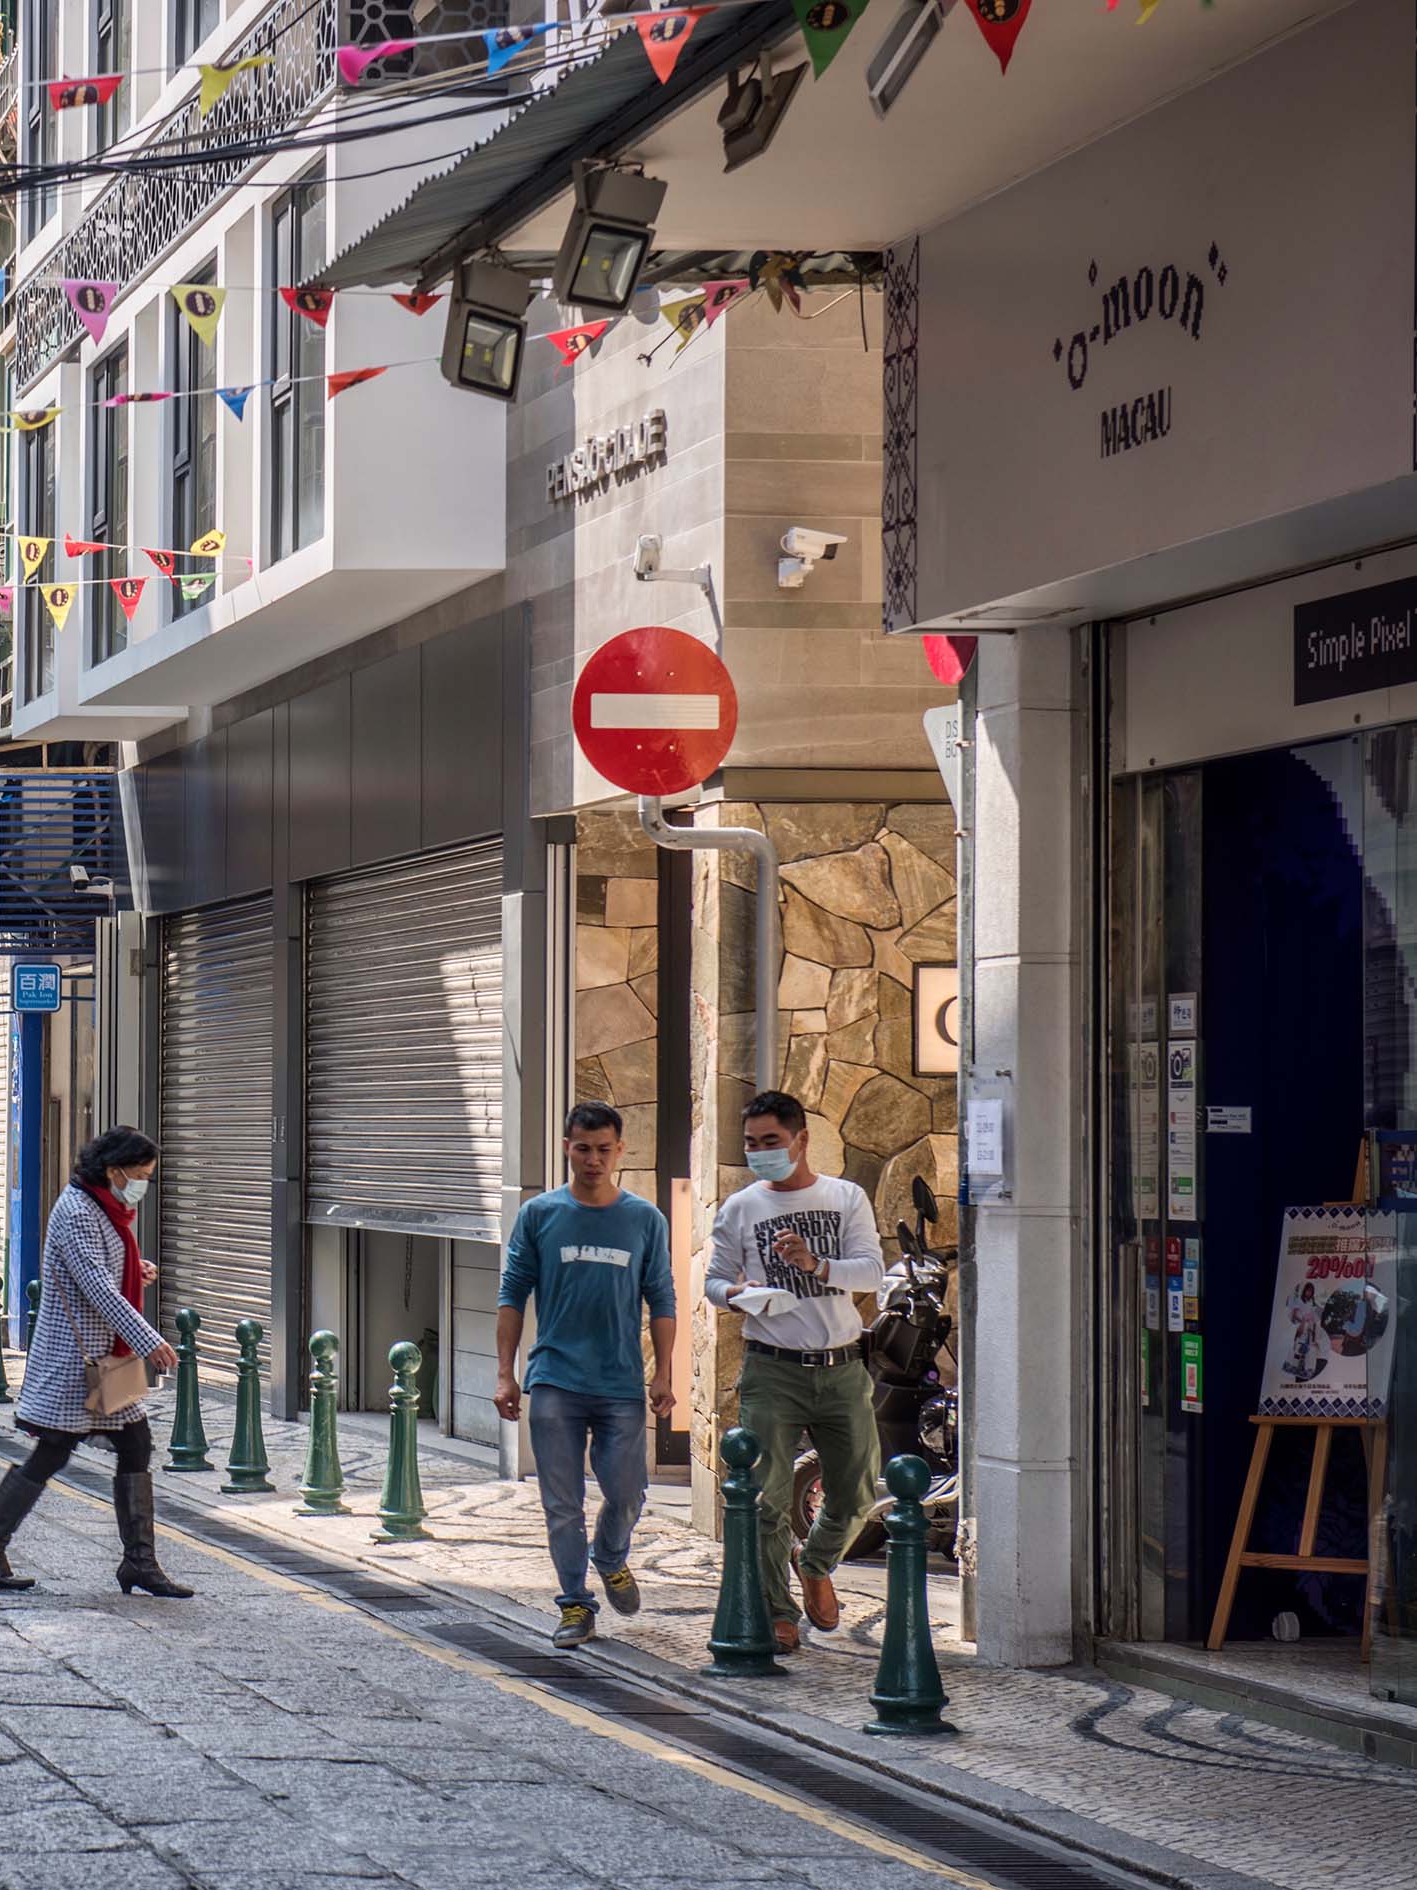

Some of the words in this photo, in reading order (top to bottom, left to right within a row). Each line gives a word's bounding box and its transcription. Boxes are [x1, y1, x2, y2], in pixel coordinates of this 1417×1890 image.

[1100, 385, 1172, 459] MACAU
[1307, 622, 1366, 672] Simple
[1370, 608, 1411, 655] Pixel
[19, 973, 56, 991] 百潤
[770, 1213, 793, 1228] NEW
[794, 1210, 841, 1222] CLOTHES
[756, 1220, 842, 1249] SARDAY
[758, 1237, 841, 1265] FAION
